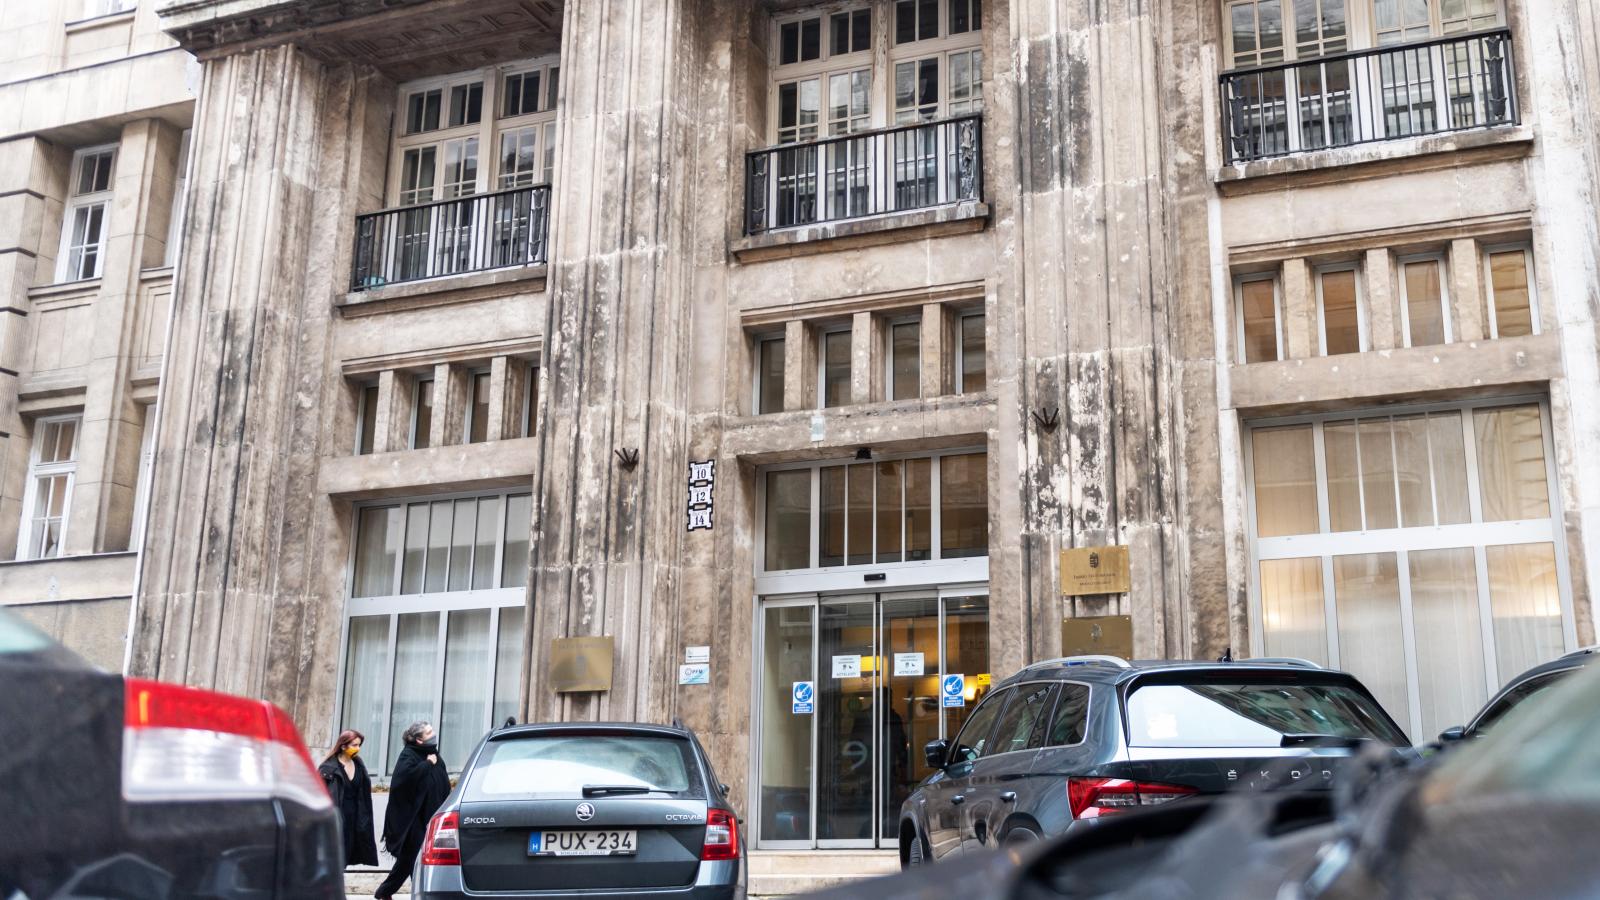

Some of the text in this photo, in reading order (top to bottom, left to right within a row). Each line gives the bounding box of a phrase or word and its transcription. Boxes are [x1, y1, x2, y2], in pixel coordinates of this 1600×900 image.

[696, 468, 707, 479] 10
[695, 491, 706, 502] 12
[695, 515, 705, 526] 14
[1227, 769, 1333, 780] ŠKOD
[665, 813, 704, 821] OCTAVIA
[532, 831, 632, 851] H PUX-234
